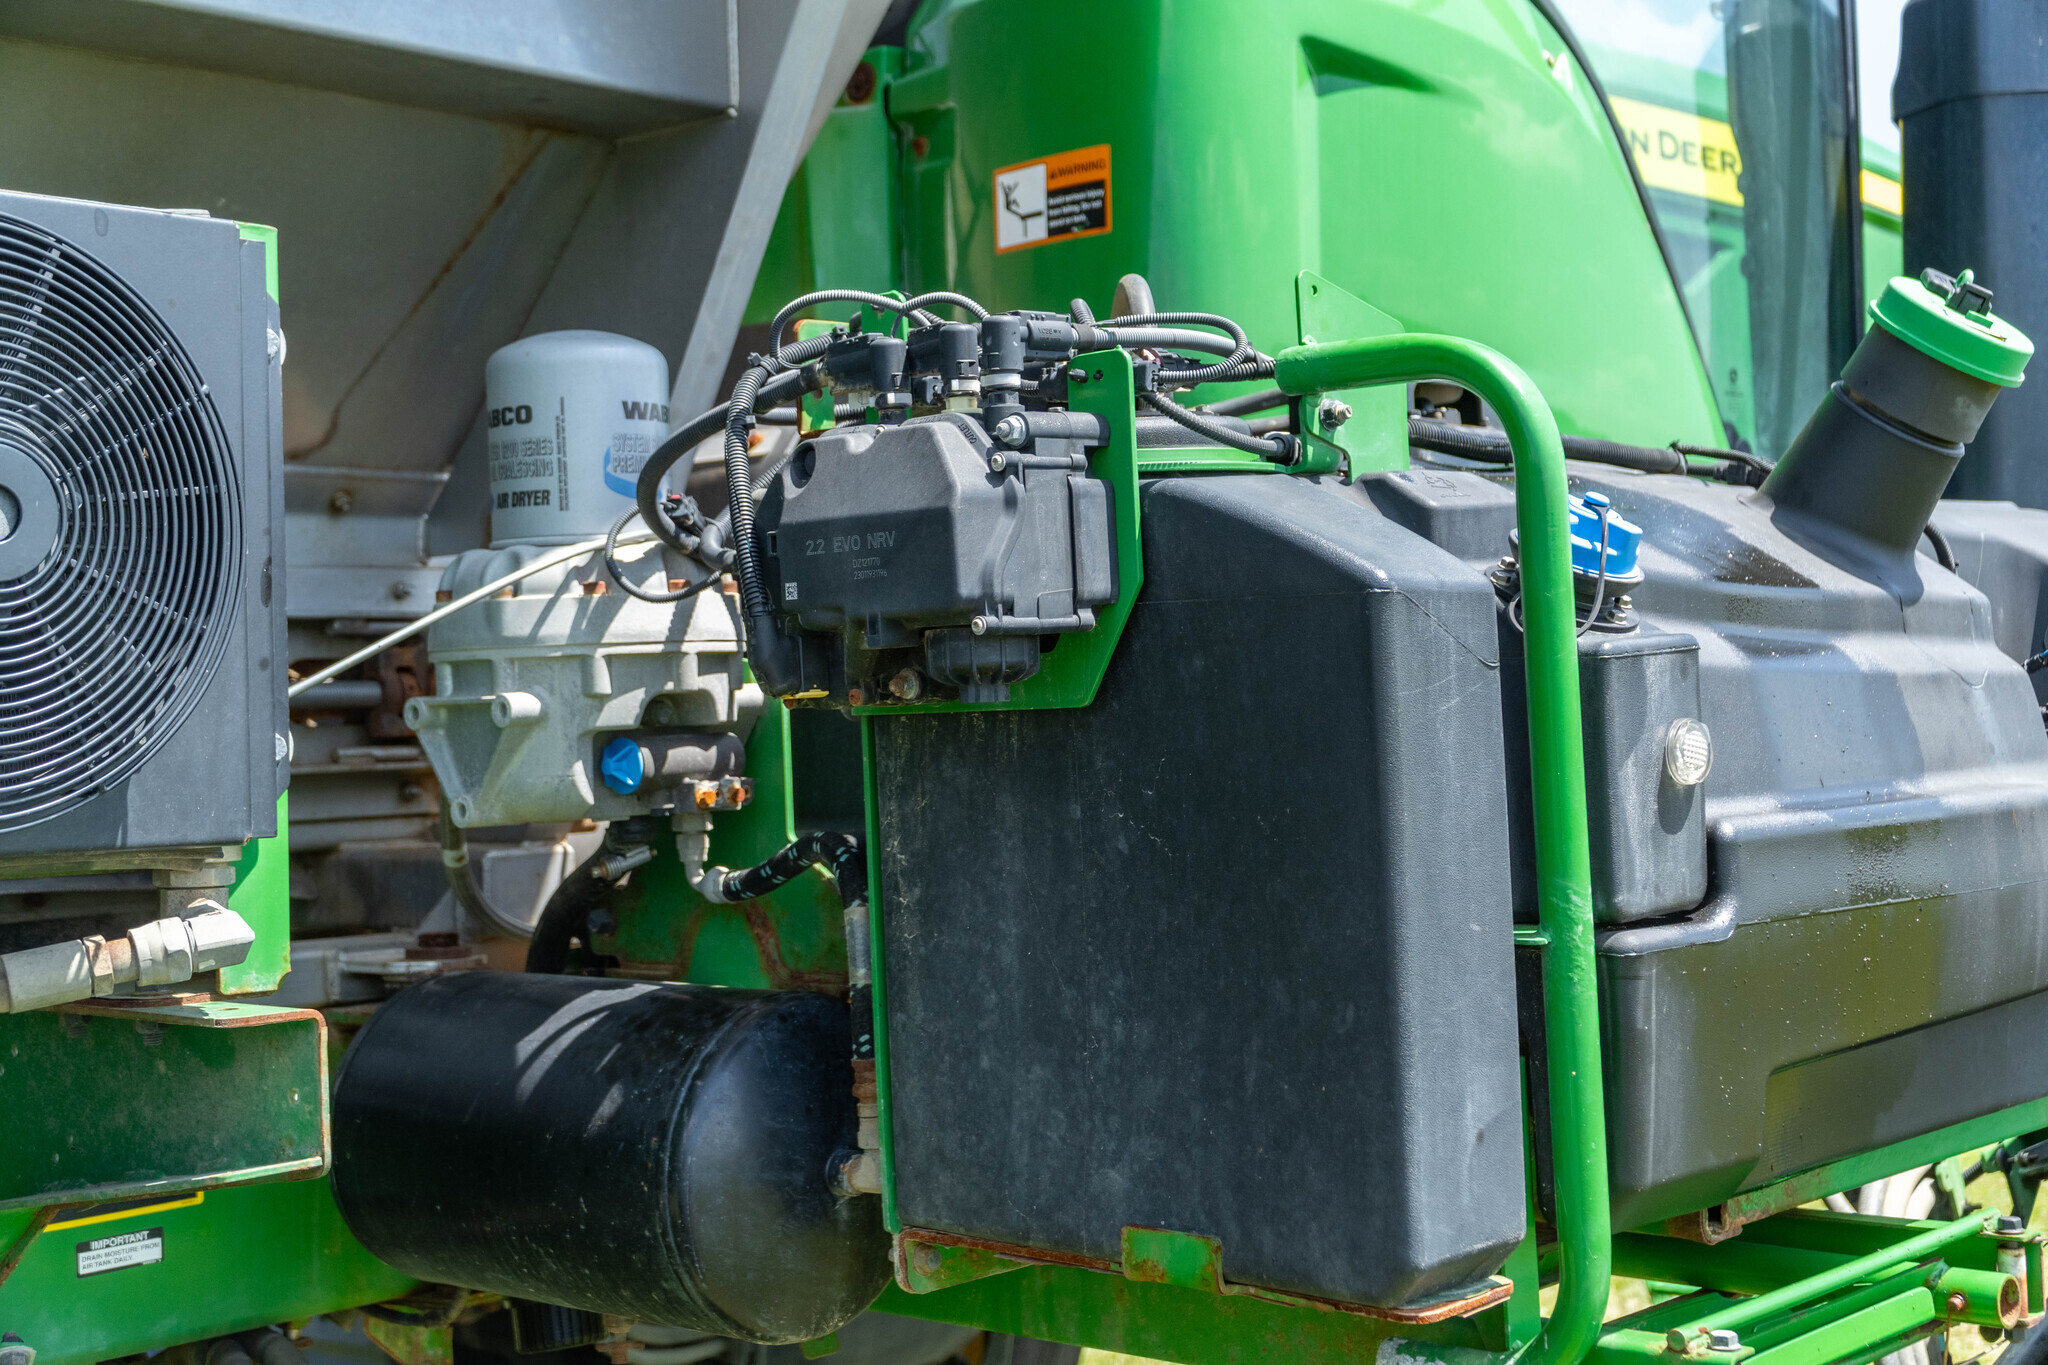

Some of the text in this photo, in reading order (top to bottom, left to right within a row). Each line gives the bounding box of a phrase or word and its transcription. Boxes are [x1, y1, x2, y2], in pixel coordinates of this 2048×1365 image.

[1658, 130, 1740, 176] DEER
[1057, 158, 1106, 177] WARNING
[622, 401, 669, 424] WAB
[957, 422, 978, 444] OUTLET
[521, 438, 554, 457] SERIES
[613, 433, 650, 454] SYSTEM
[512, 490, 551, 507] DRYER
[805, 530, 896, 556] 2.2 EVO NRV
[852, 557, 881, 568] DZ121770
[90, 1231, 150, 1251] IMPORTANT
[81, 1241, 160, 1263] DRAIN MOISTURE FROM
[82, 1262, 94, 1270] AIR
[94, 1258, 112, 1268] TANK
